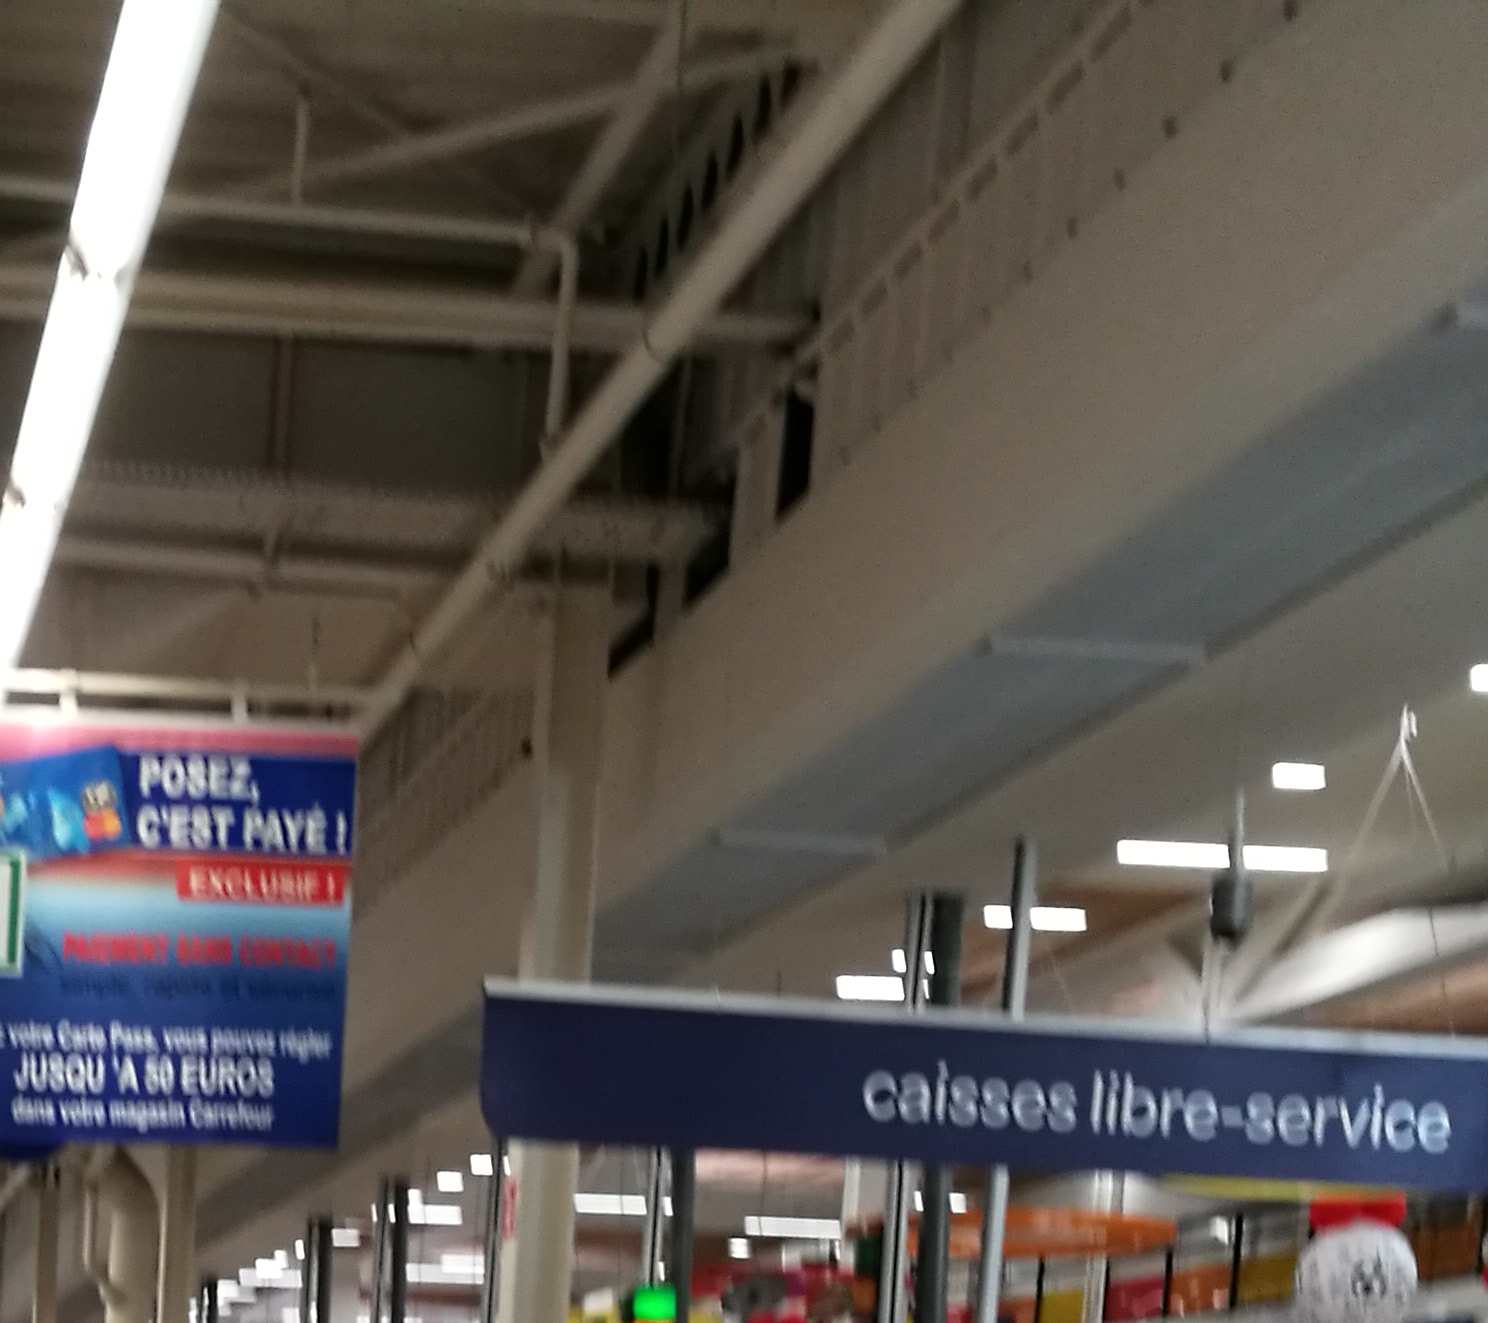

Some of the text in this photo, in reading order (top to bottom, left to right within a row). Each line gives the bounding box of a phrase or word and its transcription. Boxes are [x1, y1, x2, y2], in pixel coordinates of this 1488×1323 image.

[139, 752, 259, 806] POSEZ,
[137, 803, 236, 851] C'EST
[243, 802, 327, 855] PAYÉ
[180, 1052, 275, 1099] EUROS
[863, 1059, 1451, 1155] caisses libre-service
